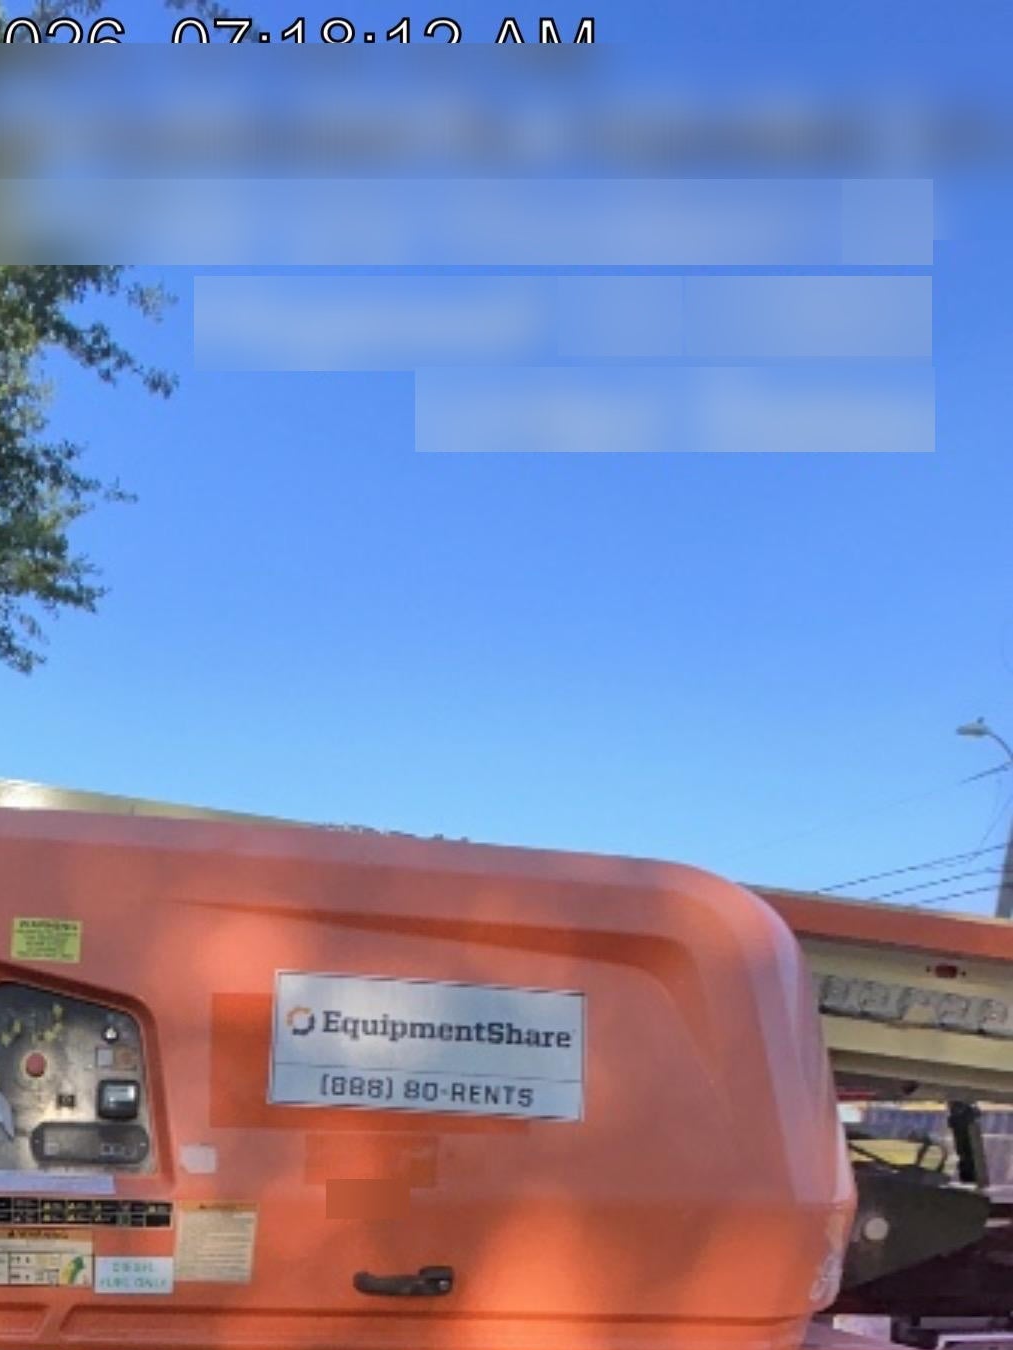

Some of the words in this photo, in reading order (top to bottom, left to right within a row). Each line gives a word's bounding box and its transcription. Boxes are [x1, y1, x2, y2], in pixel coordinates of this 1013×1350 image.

[322, 1009, 572, 1048] EquipmentShare
[320, 1073, 394, 1099] (888)
[403, 1078, 534, 1108] 80-RENTS
